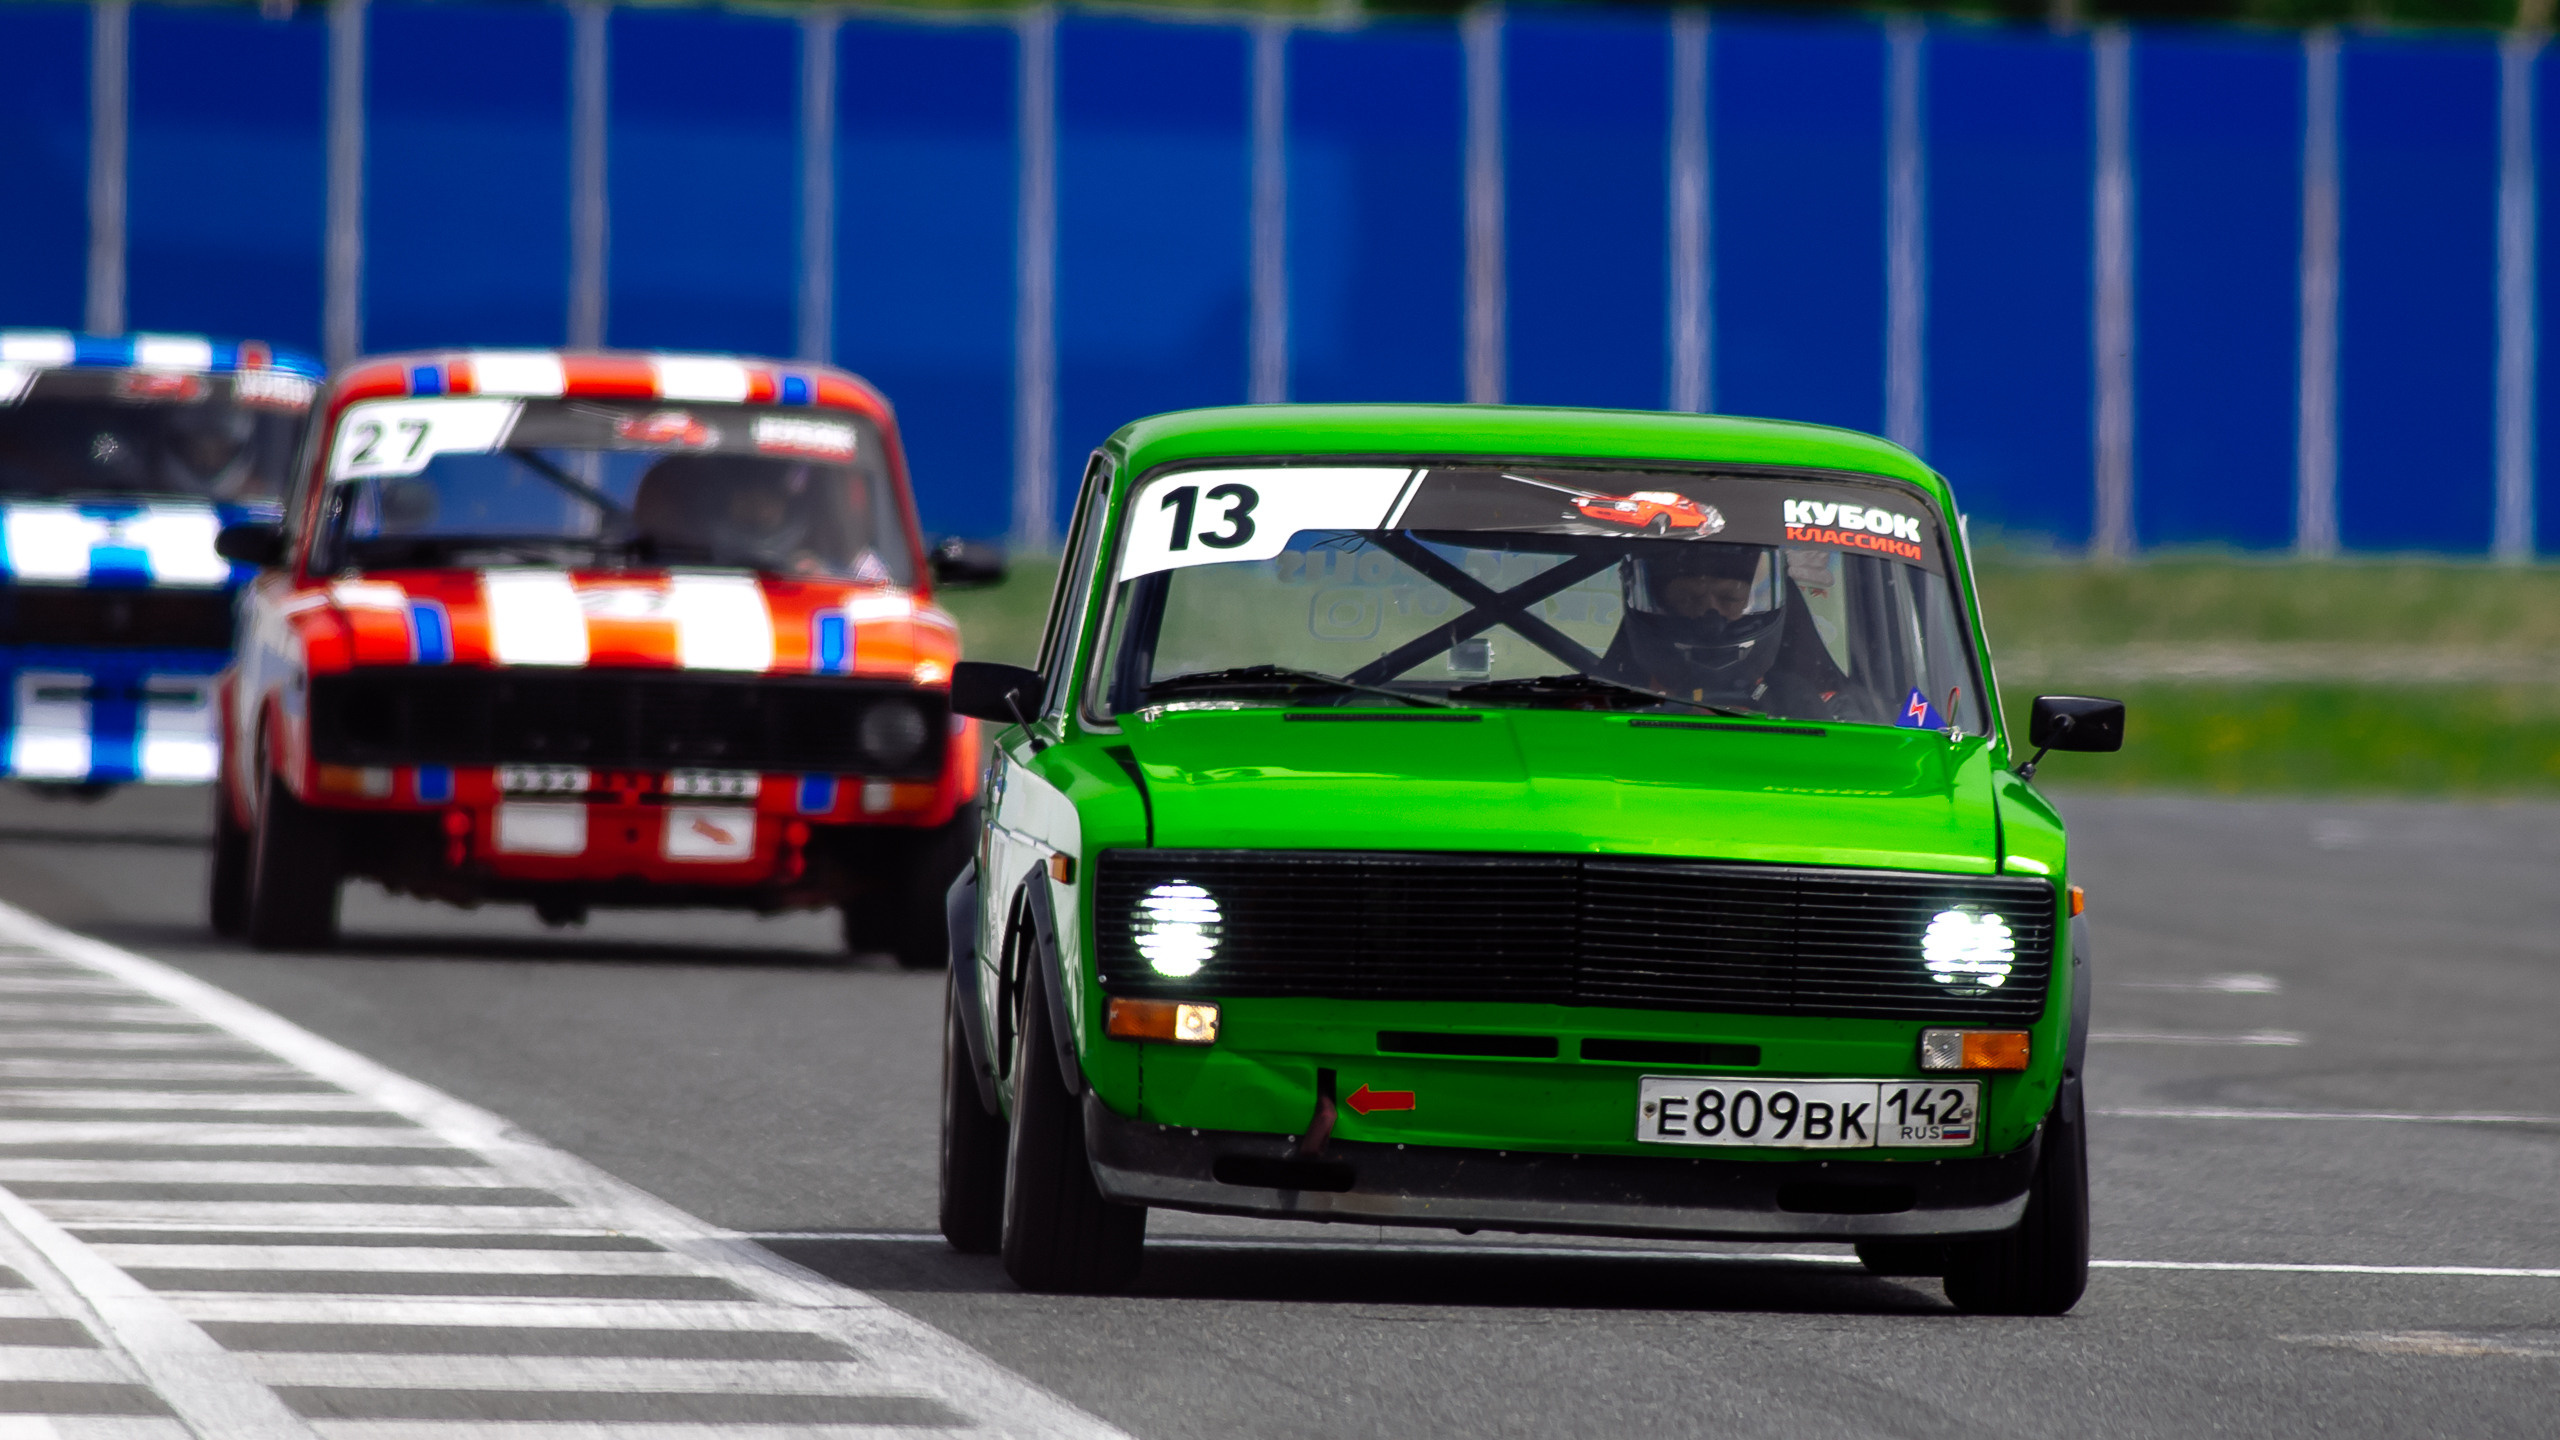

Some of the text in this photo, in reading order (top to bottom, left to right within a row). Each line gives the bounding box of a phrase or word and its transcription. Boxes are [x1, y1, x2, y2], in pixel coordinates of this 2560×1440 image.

[351, 421, 431, 466] 27
[1160, 483, 1260, 552] 13
[1783, 499, 1922, 543] КУБОК
[1785, 526, 1922, 561] КЛАССИКИ
[1657, 1087, 1966, 1140] Е809ВК 142
[1900, 1125, 1941, 1140] RUS
